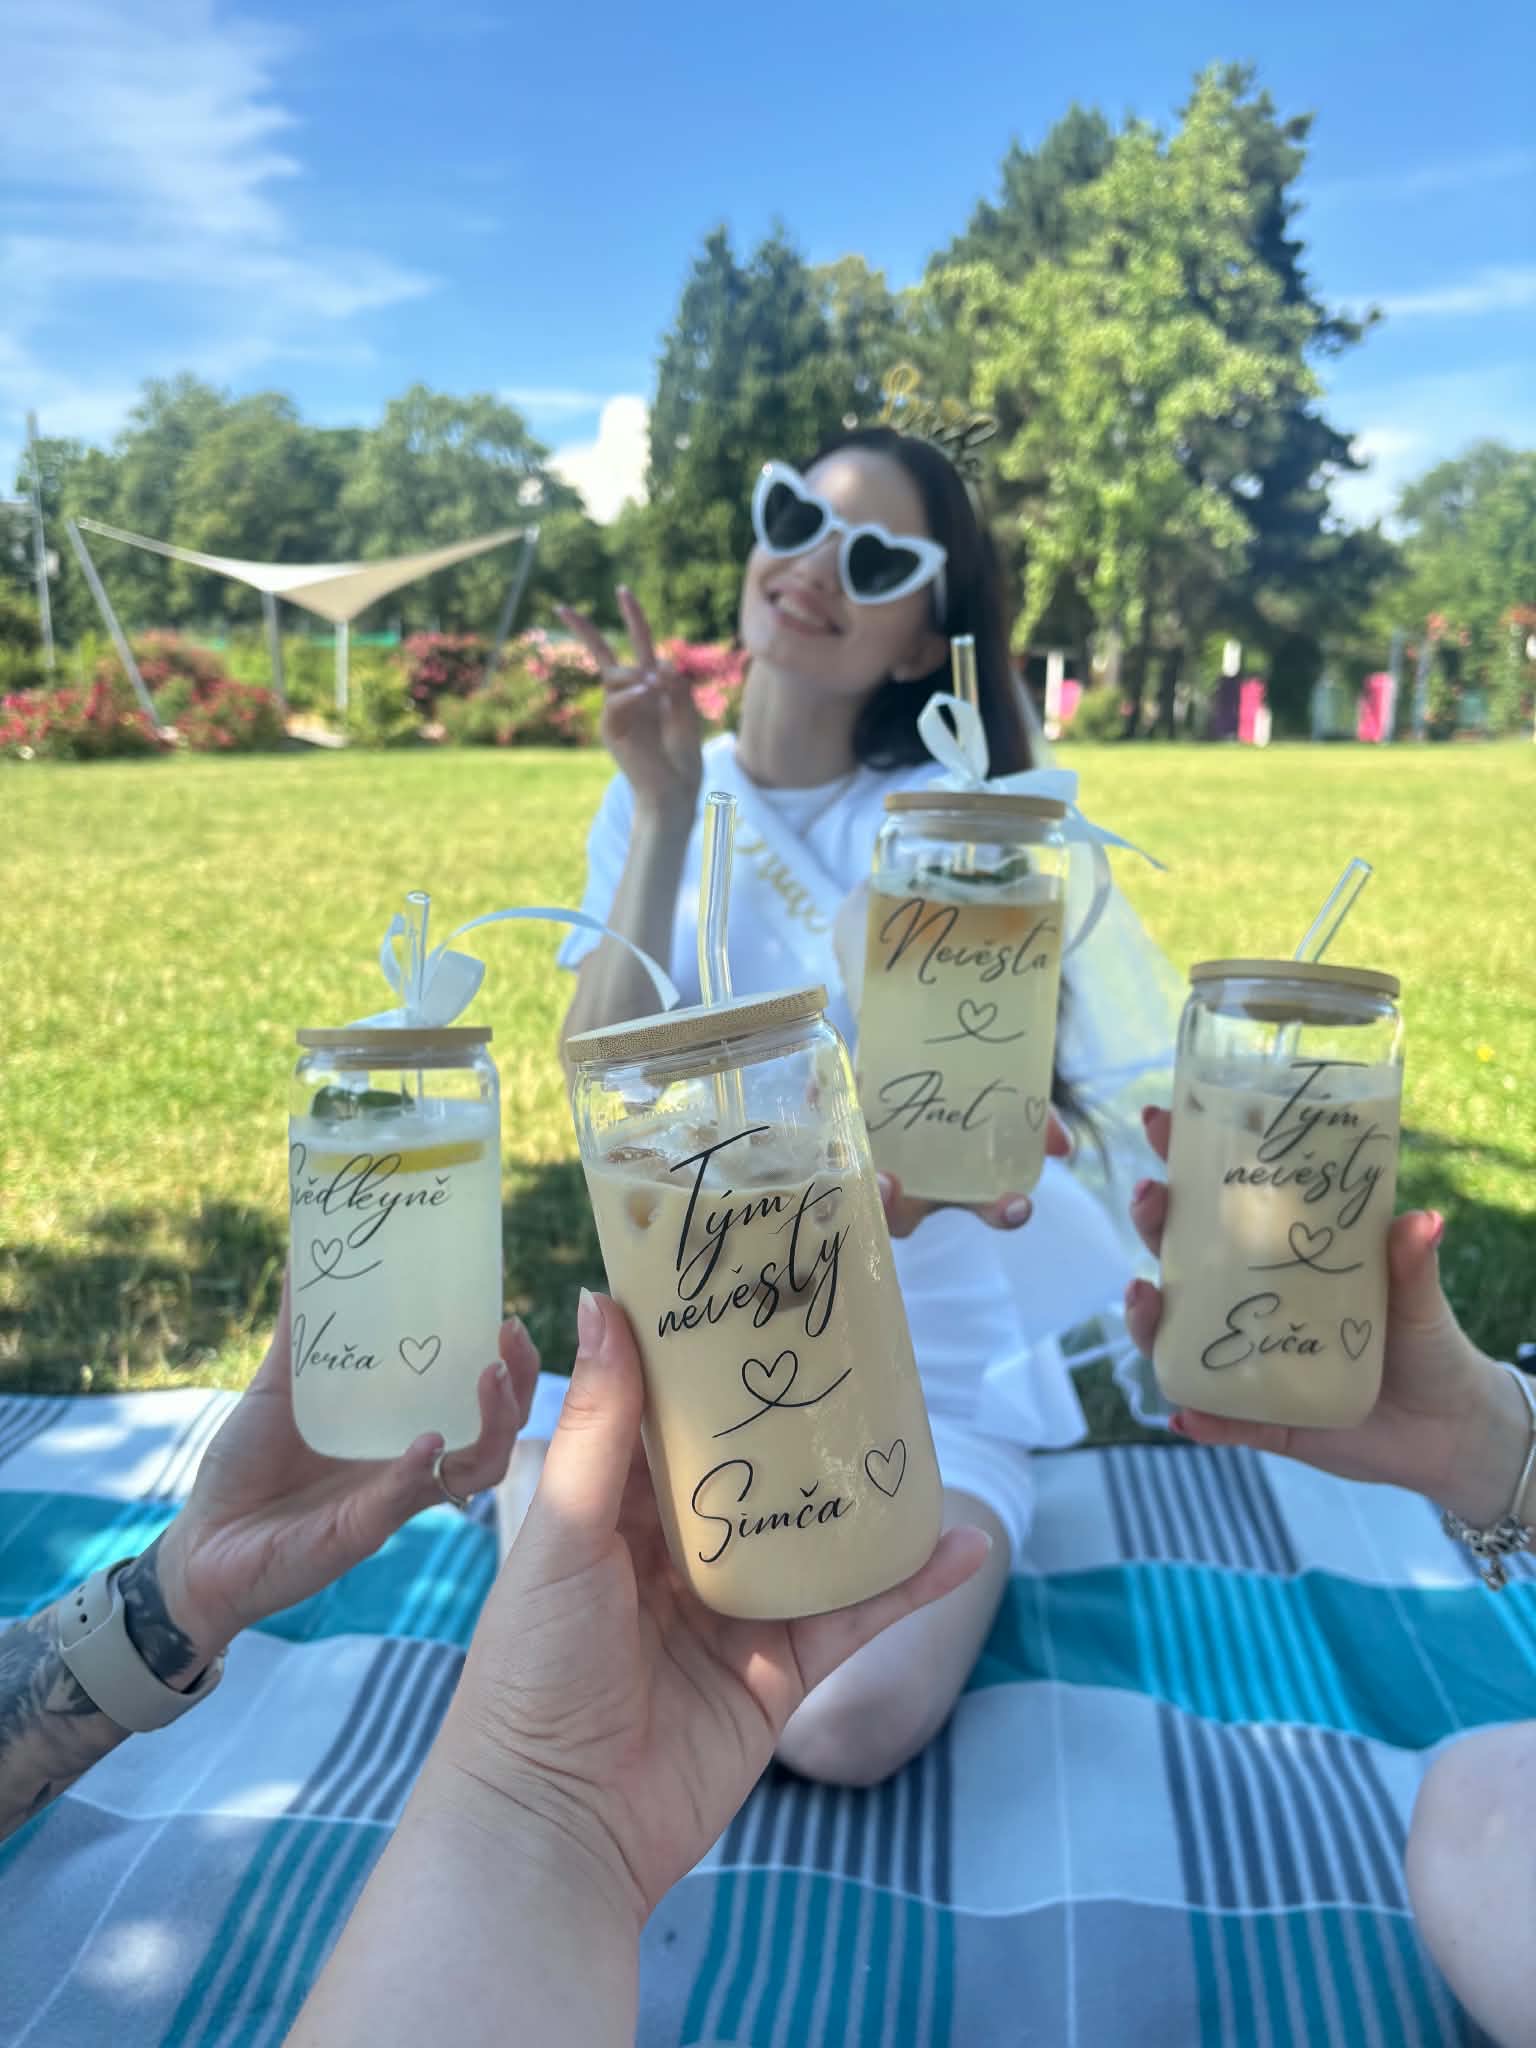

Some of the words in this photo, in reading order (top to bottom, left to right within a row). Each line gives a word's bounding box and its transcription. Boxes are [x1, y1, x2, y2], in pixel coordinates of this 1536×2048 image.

[880, 896, 1057, 985] Nevěsta
[1257, 1060, 1368, 1162] Tým
[669, 1125, 796, 1301] Tým
[1223, 1123, 1391, 1230] nevěsty
[658, 1182, 851, 1338] nevěsty
[294, 1311, 380, 1377] Verča
[1201, 1292, 1326, 1371] Evča
[692, 1459, 856, 1564] Simča
